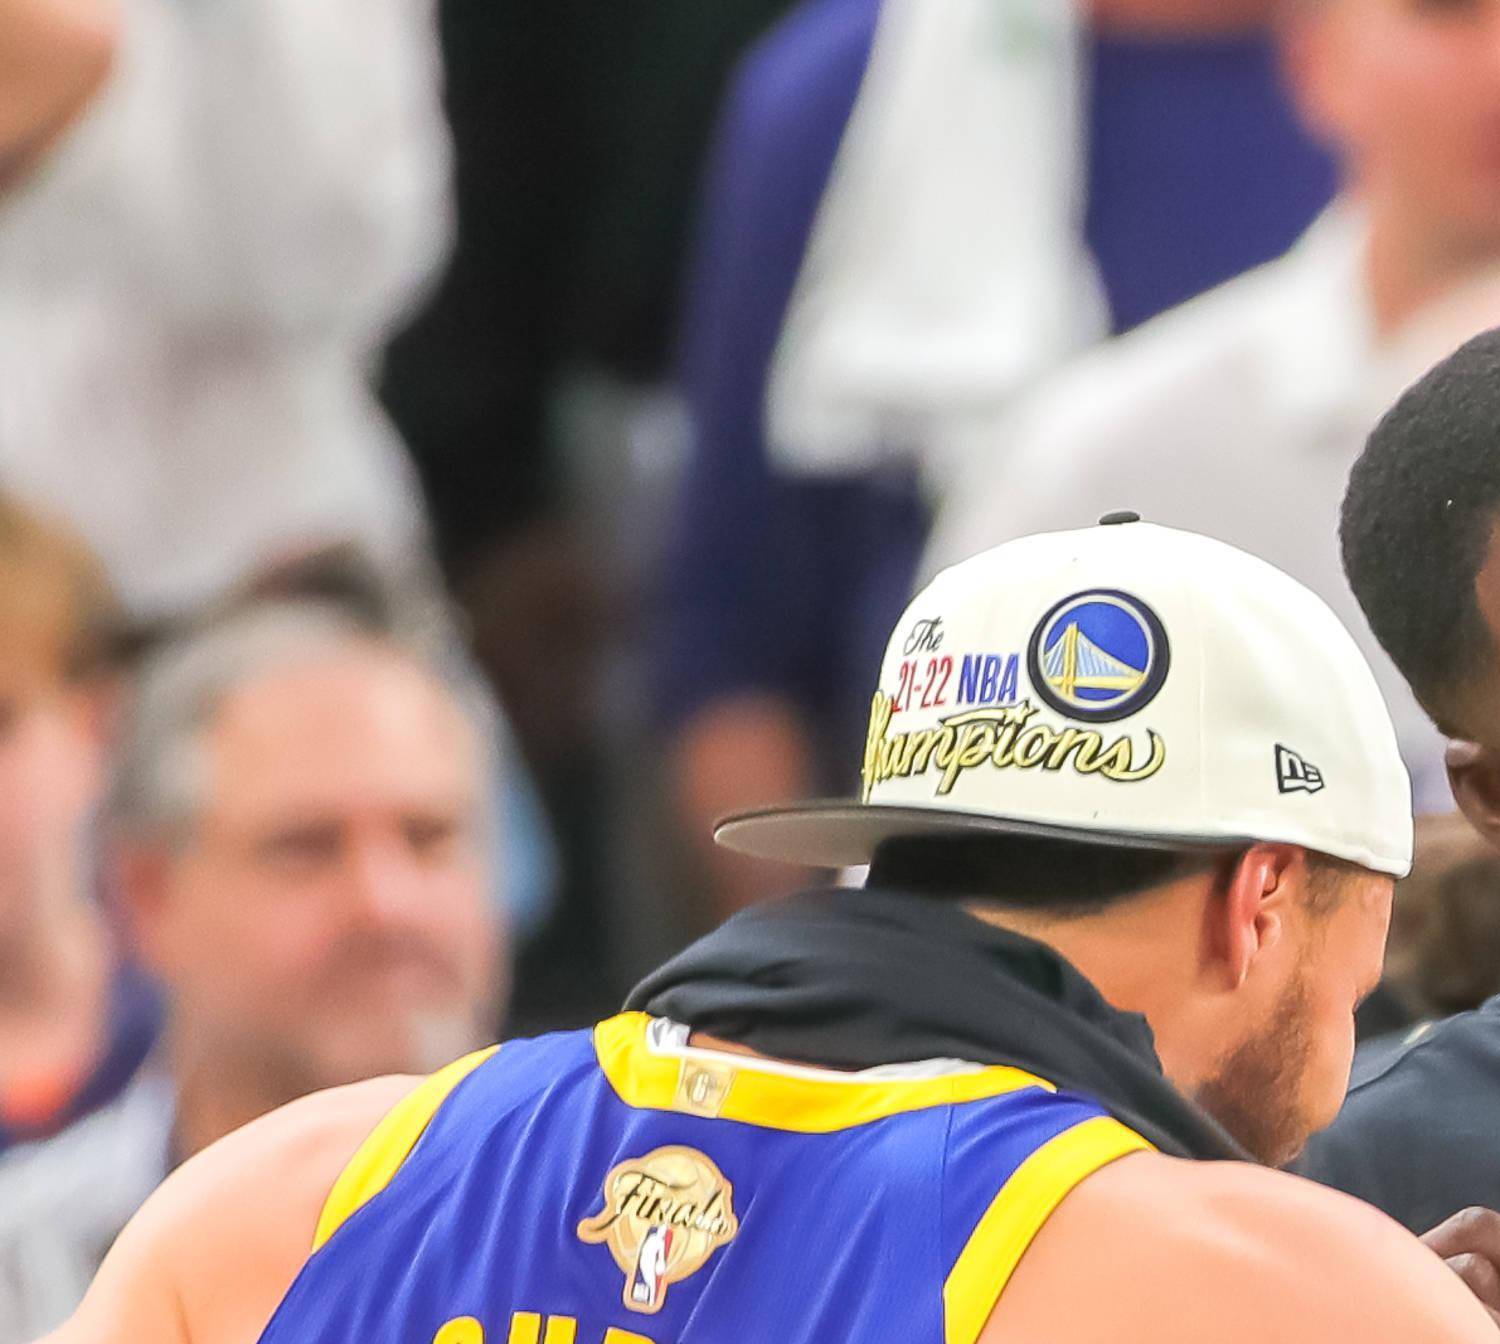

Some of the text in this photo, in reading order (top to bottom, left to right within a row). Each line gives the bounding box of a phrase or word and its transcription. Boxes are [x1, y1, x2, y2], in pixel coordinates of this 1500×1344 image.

[903, 616, 944, 657] The
[891, 653, 1020, 713] 21-22 NBA
[592, 1171, 730, 1237] Finals
